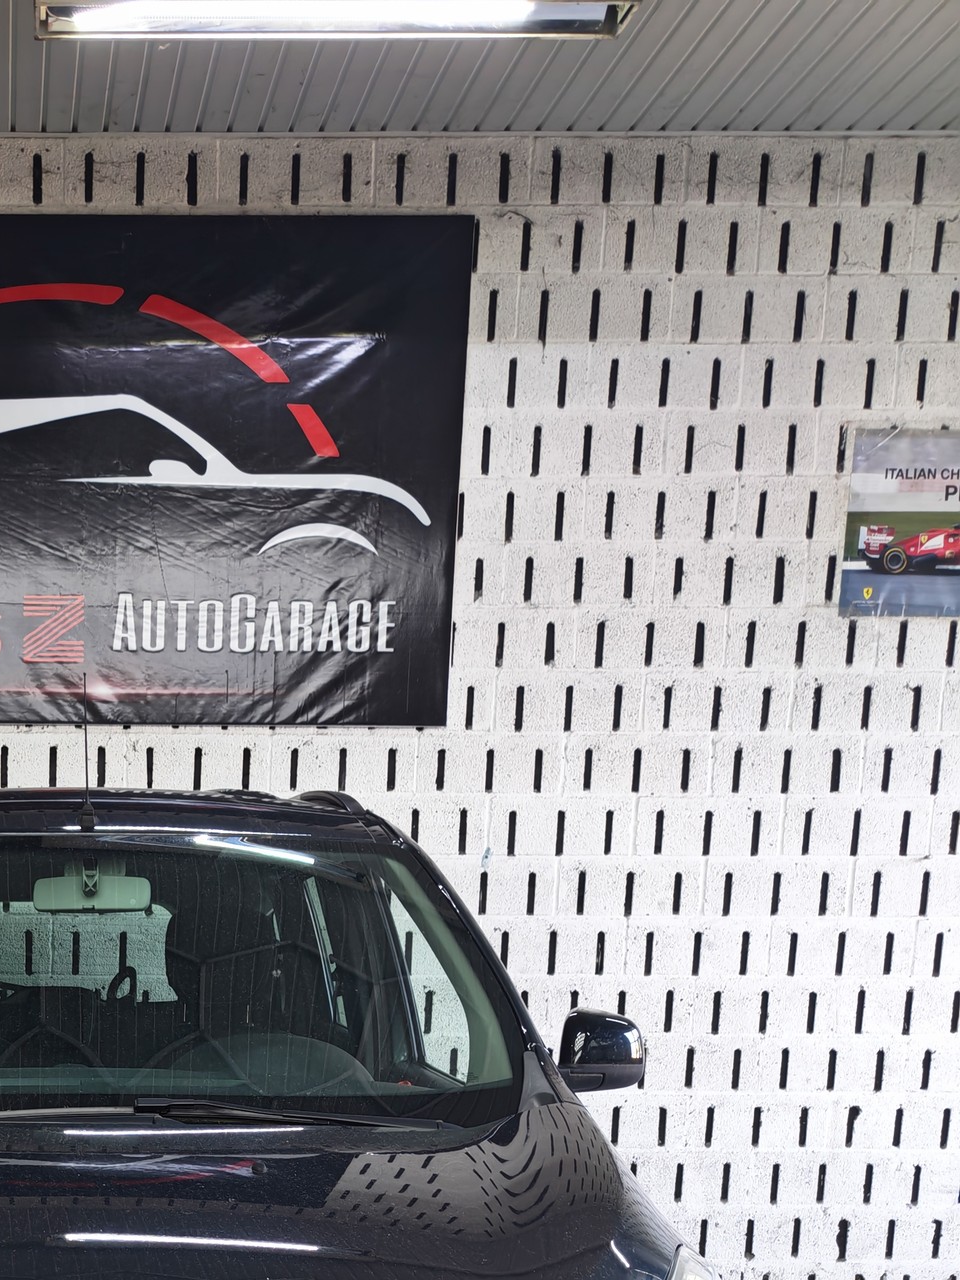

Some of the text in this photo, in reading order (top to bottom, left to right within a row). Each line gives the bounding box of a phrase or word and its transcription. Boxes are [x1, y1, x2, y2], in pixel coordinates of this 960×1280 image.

[885, 467, 937, 480] ITALIAN
[944, 484, 960, 502] P
[22, 594, 85, 663] Z
